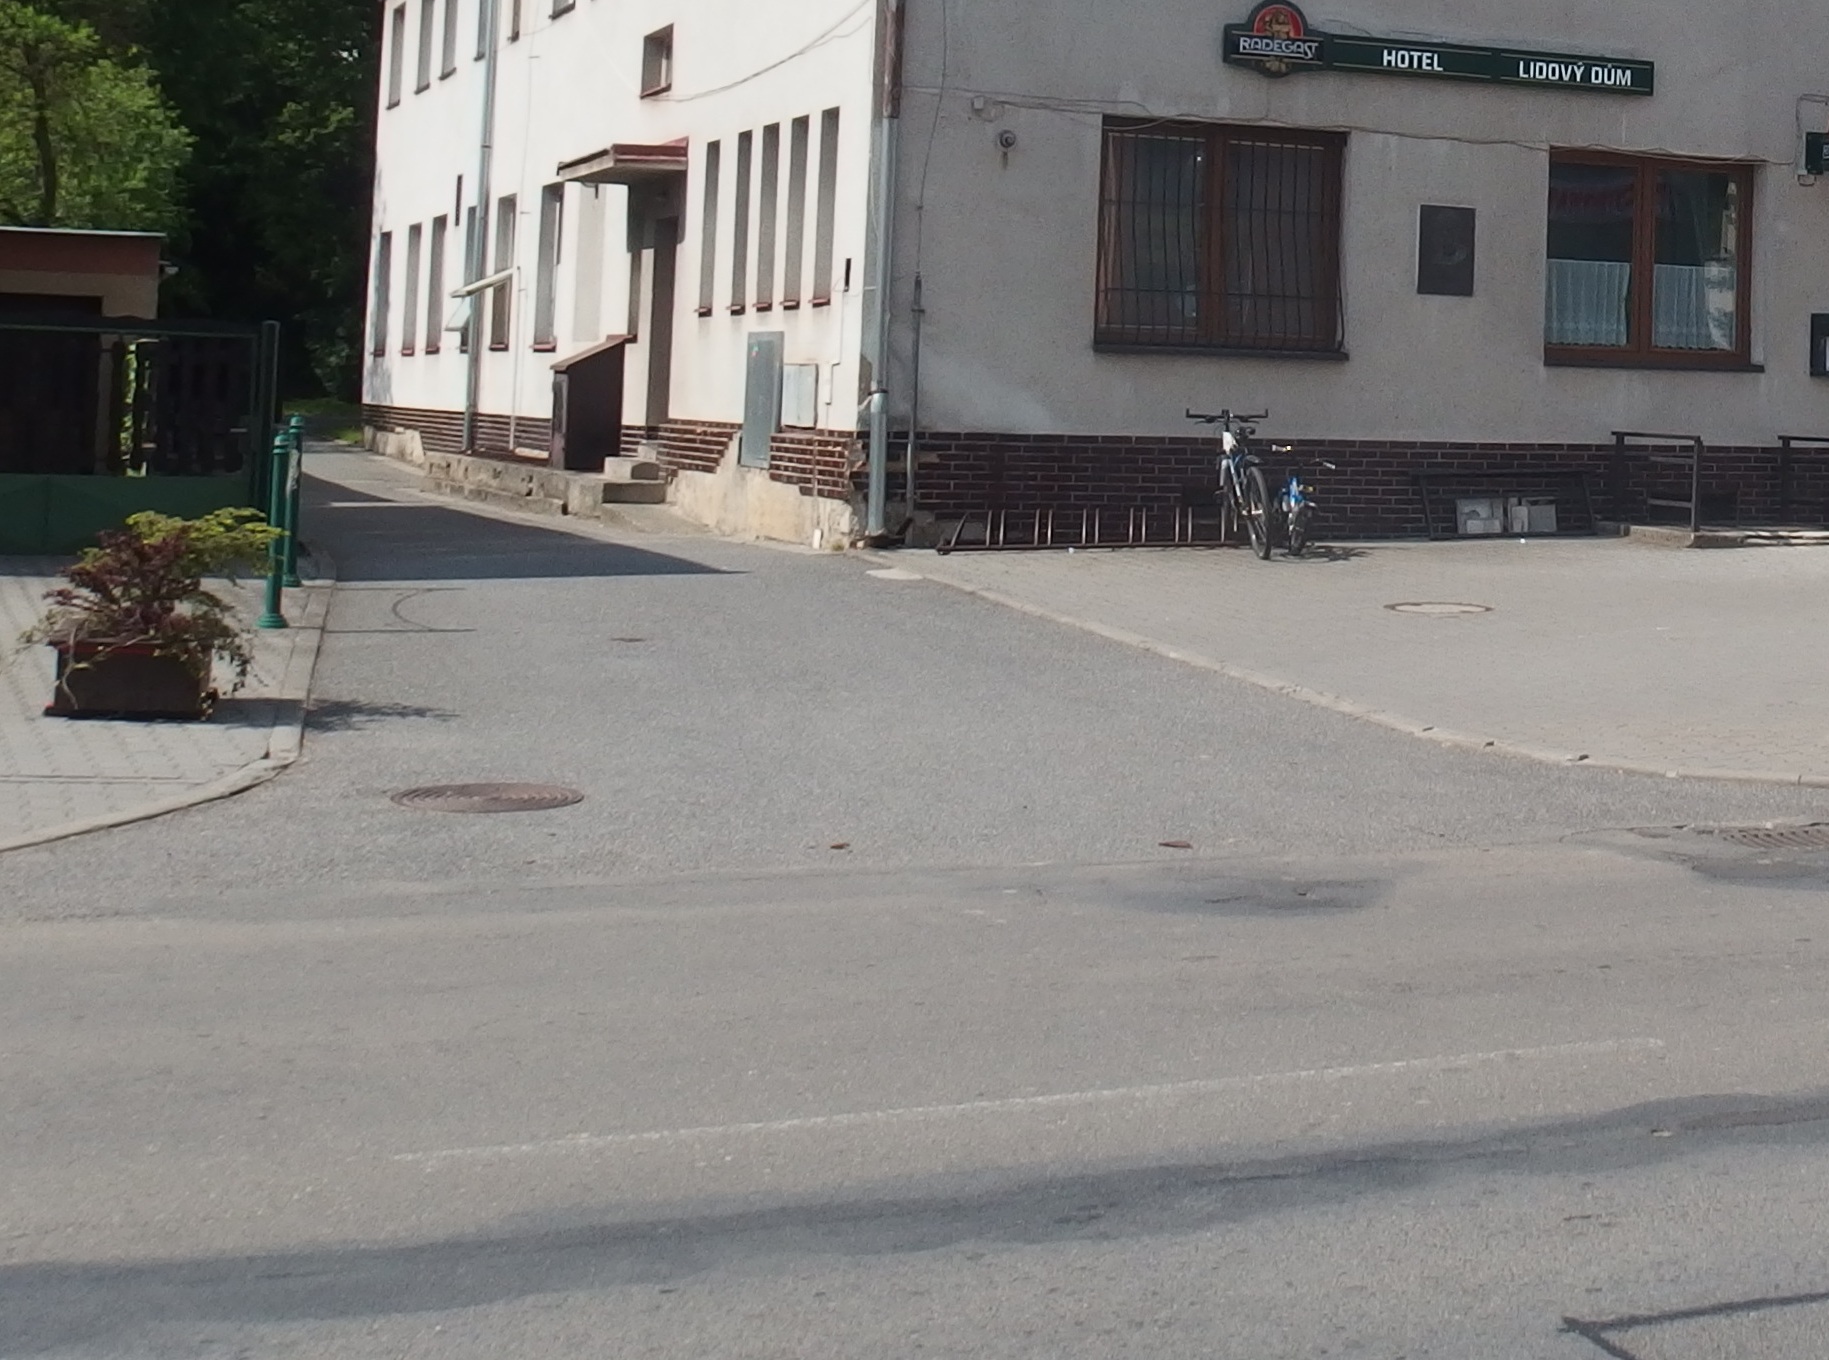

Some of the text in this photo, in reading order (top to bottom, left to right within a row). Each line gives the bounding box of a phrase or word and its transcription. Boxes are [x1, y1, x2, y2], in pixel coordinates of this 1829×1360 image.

[1239, 36, 1319, 60] RADEGAST
[1382, 49, 1632, 87] HOTEL LIDOVÝ DŮM
